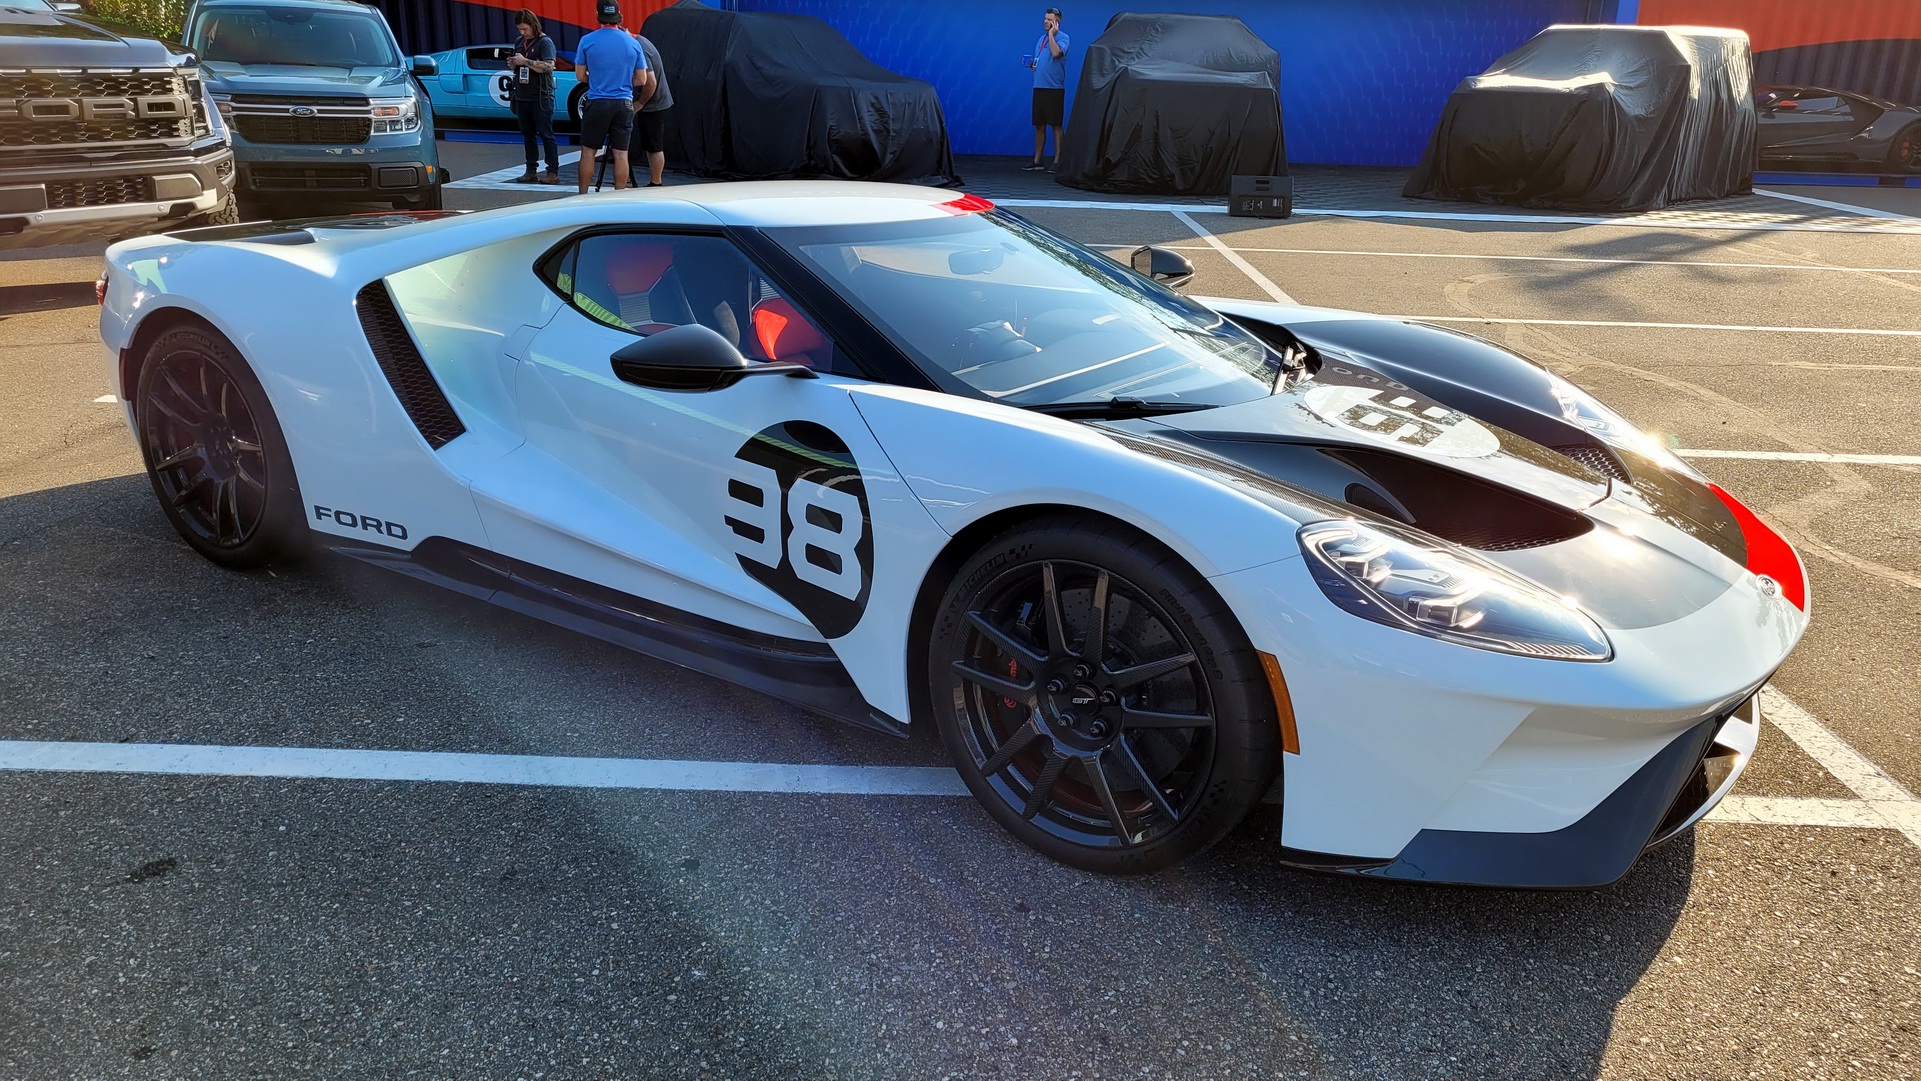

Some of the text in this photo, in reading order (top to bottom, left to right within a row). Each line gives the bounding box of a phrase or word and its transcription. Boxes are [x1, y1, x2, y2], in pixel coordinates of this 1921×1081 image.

[313, 504, 409, 541] FORD
[722, 455, 864, 602] 98
[957, 552, 1008, 600] MICHELIN
